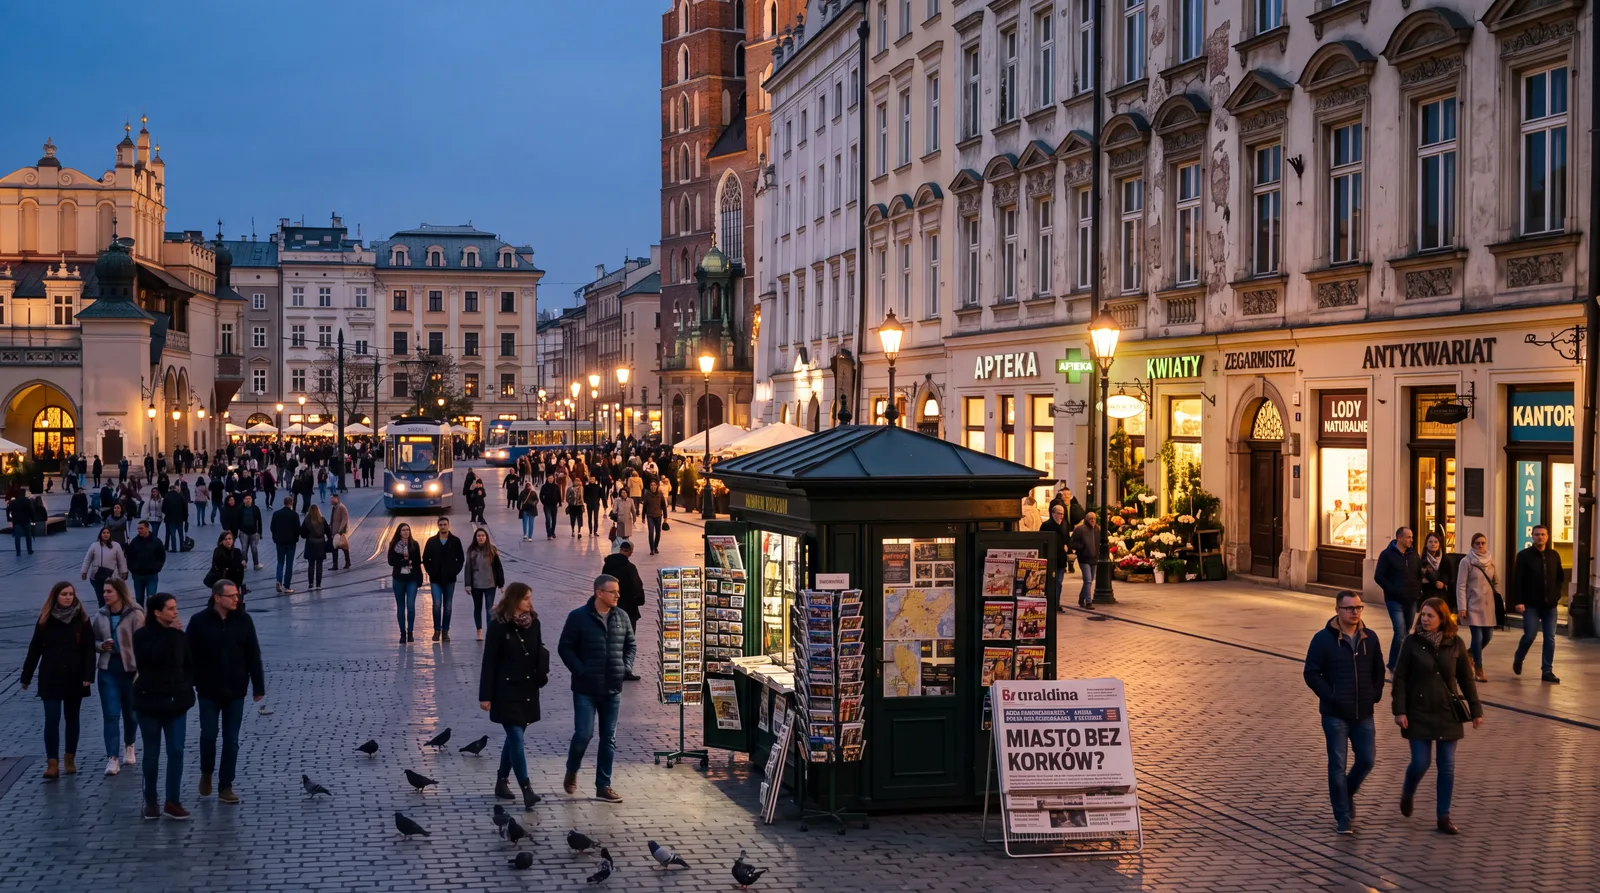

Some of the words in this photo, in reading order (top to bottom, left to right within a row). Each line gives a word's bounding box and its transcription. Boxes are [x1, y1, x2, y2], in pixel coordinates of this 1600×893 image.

[1225, 349, 1296, 370] ZEGARMISTRZ
[1362, 337, 1497, 369] ANTYKWARIAT
[974, 352, 1039, 379] APTEKA
[1146, 355, 1202, 379] KWIATY
[1331, 400, 1362, 418] LODY
[1513, 405, 1574, 427] KANTOR
[1324, 420, 1368, 433] NATURALNE
[1006, 729, 1081, 748] MIASTO
[1085, 728, 1122, 747] BEZ
[1008, 747, 1105, 771] KORKÓW?
